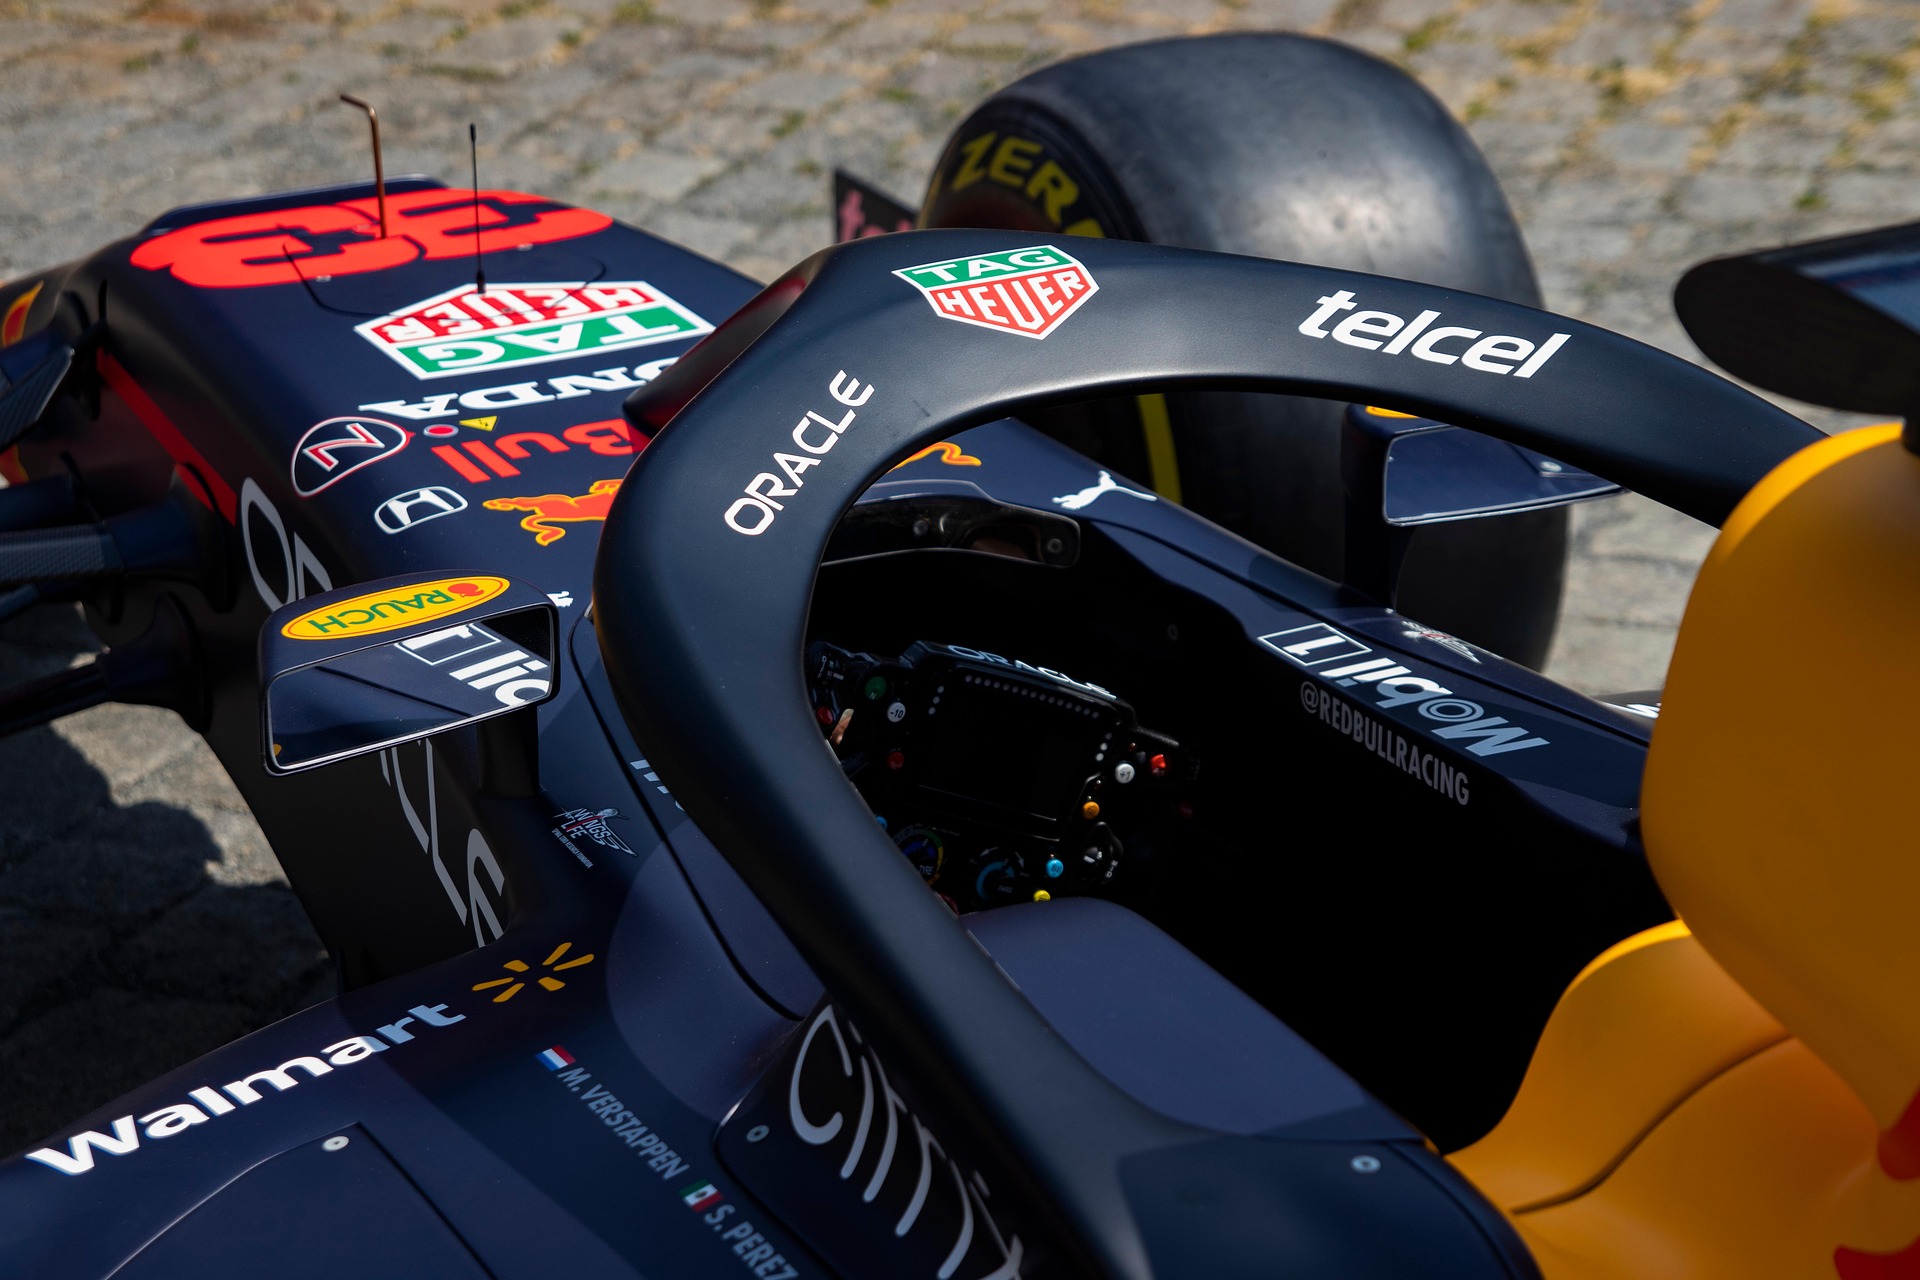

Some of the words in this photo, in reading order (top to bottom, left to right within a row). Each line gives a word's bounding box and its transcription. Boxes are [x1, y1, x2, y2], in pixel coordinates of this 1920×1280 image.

[912, 250, 1059, 282] TAG
[384, 287, 648, 340] HEUER
[937, 270, 1085, 331] HEUER
[417, 314, 680, 368] TAG
[1298, 289, 1571, 379] telcel
[430, 419, 653, 484] Bull
[723, 369, 875, 537] ORACLE
[307, 589, 455, 633] RAUCH
[1282, 635, 1347, 656] 1
[1319, 657, 1550, 757] Mobil
[1300, 681, 1470, 805] @REDBULLRACING
[575, 808, 611, 839] WINGS
[25, 1002, 466, 1177] Walmart
[557, 1067, 592, 1092] M.
[580, 1083, 690, 1180] VERSTAPPEN
[704, 1204, 735, 1232] S.
[722, 1221, 800, 1280] PEREZ
